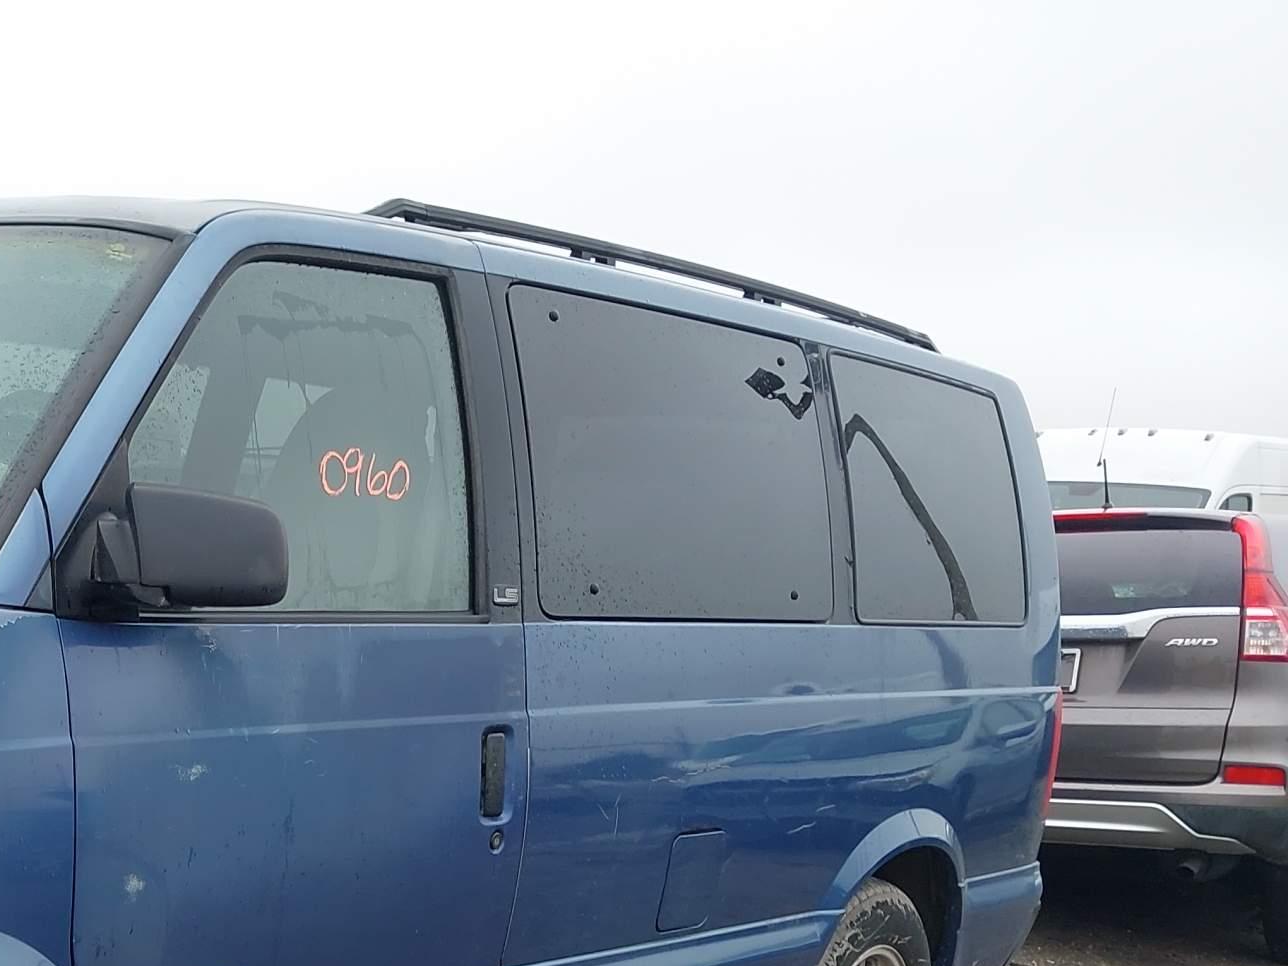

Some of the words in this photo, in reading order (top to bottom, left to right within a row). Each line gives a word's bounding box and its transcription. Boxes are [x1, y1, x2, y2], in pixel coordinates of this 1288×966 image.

[319, 448, 410, 500] 0960
[493, 587, 519, 603] LS
[1164, 638, 1219, 647] AWD
